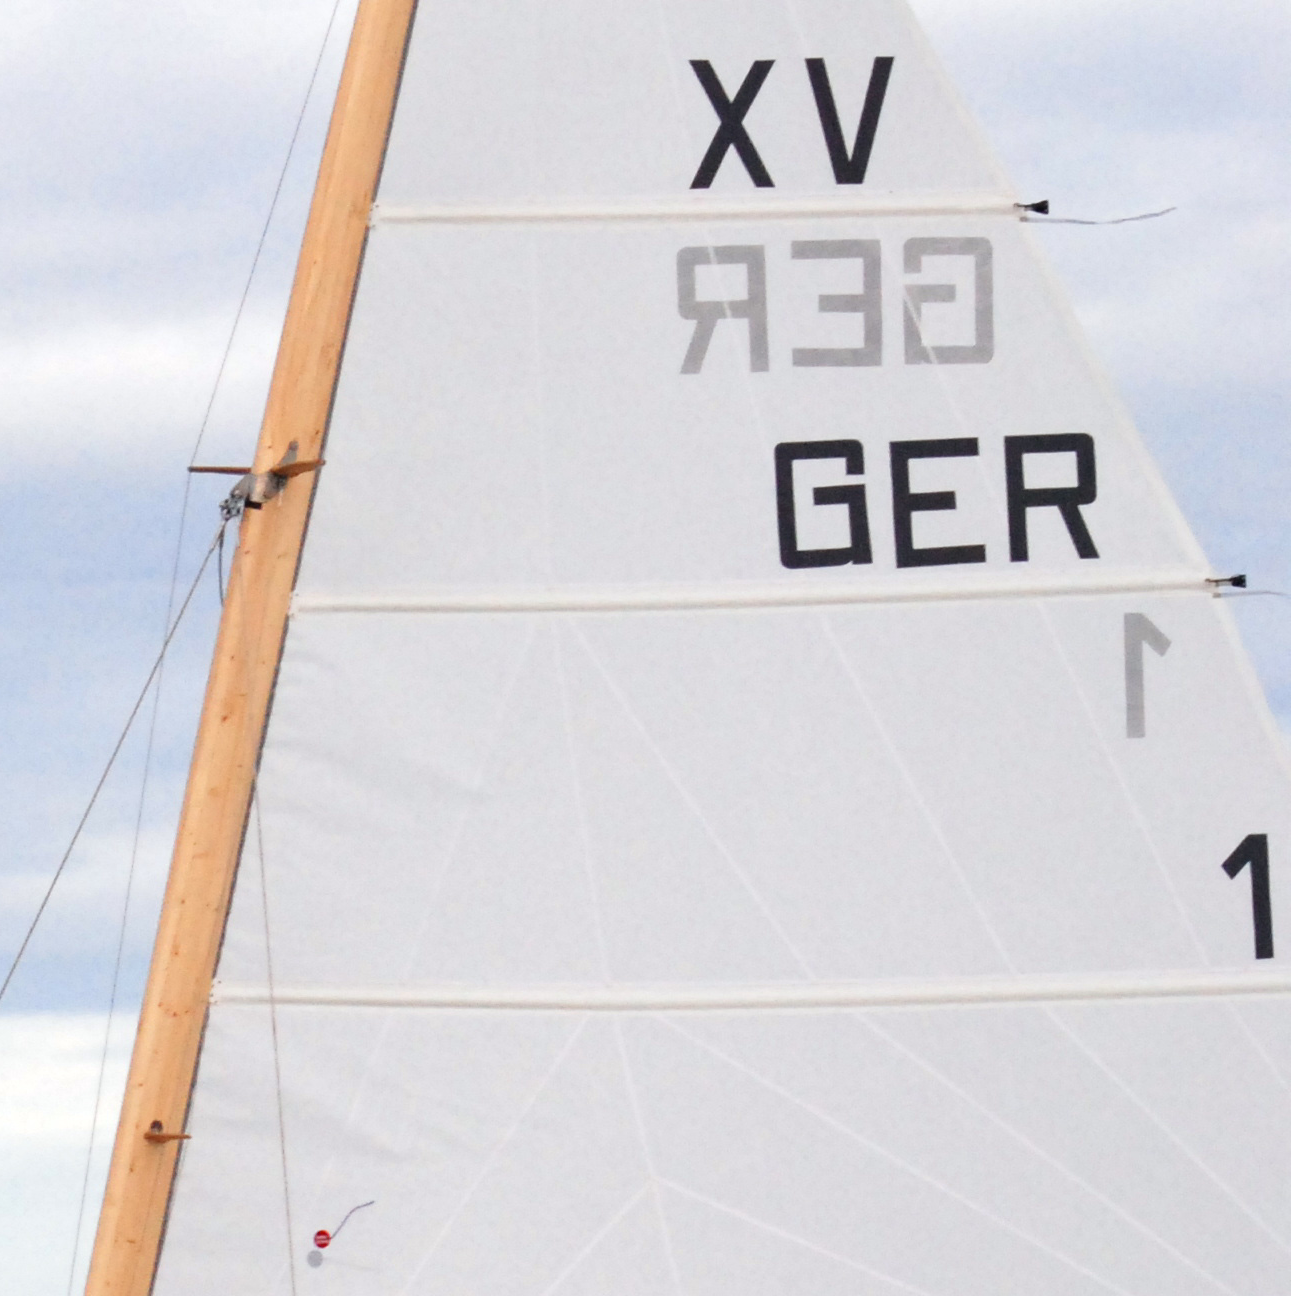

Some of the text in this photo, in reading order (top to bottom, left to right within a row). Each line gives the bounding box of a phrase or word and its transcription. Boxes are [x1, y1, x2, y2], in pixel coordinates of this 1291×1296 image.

[689, 57, 894, 187] XV
[775, 433, 1099, 569] GER
[1222, 834, 1274, 959] 1
